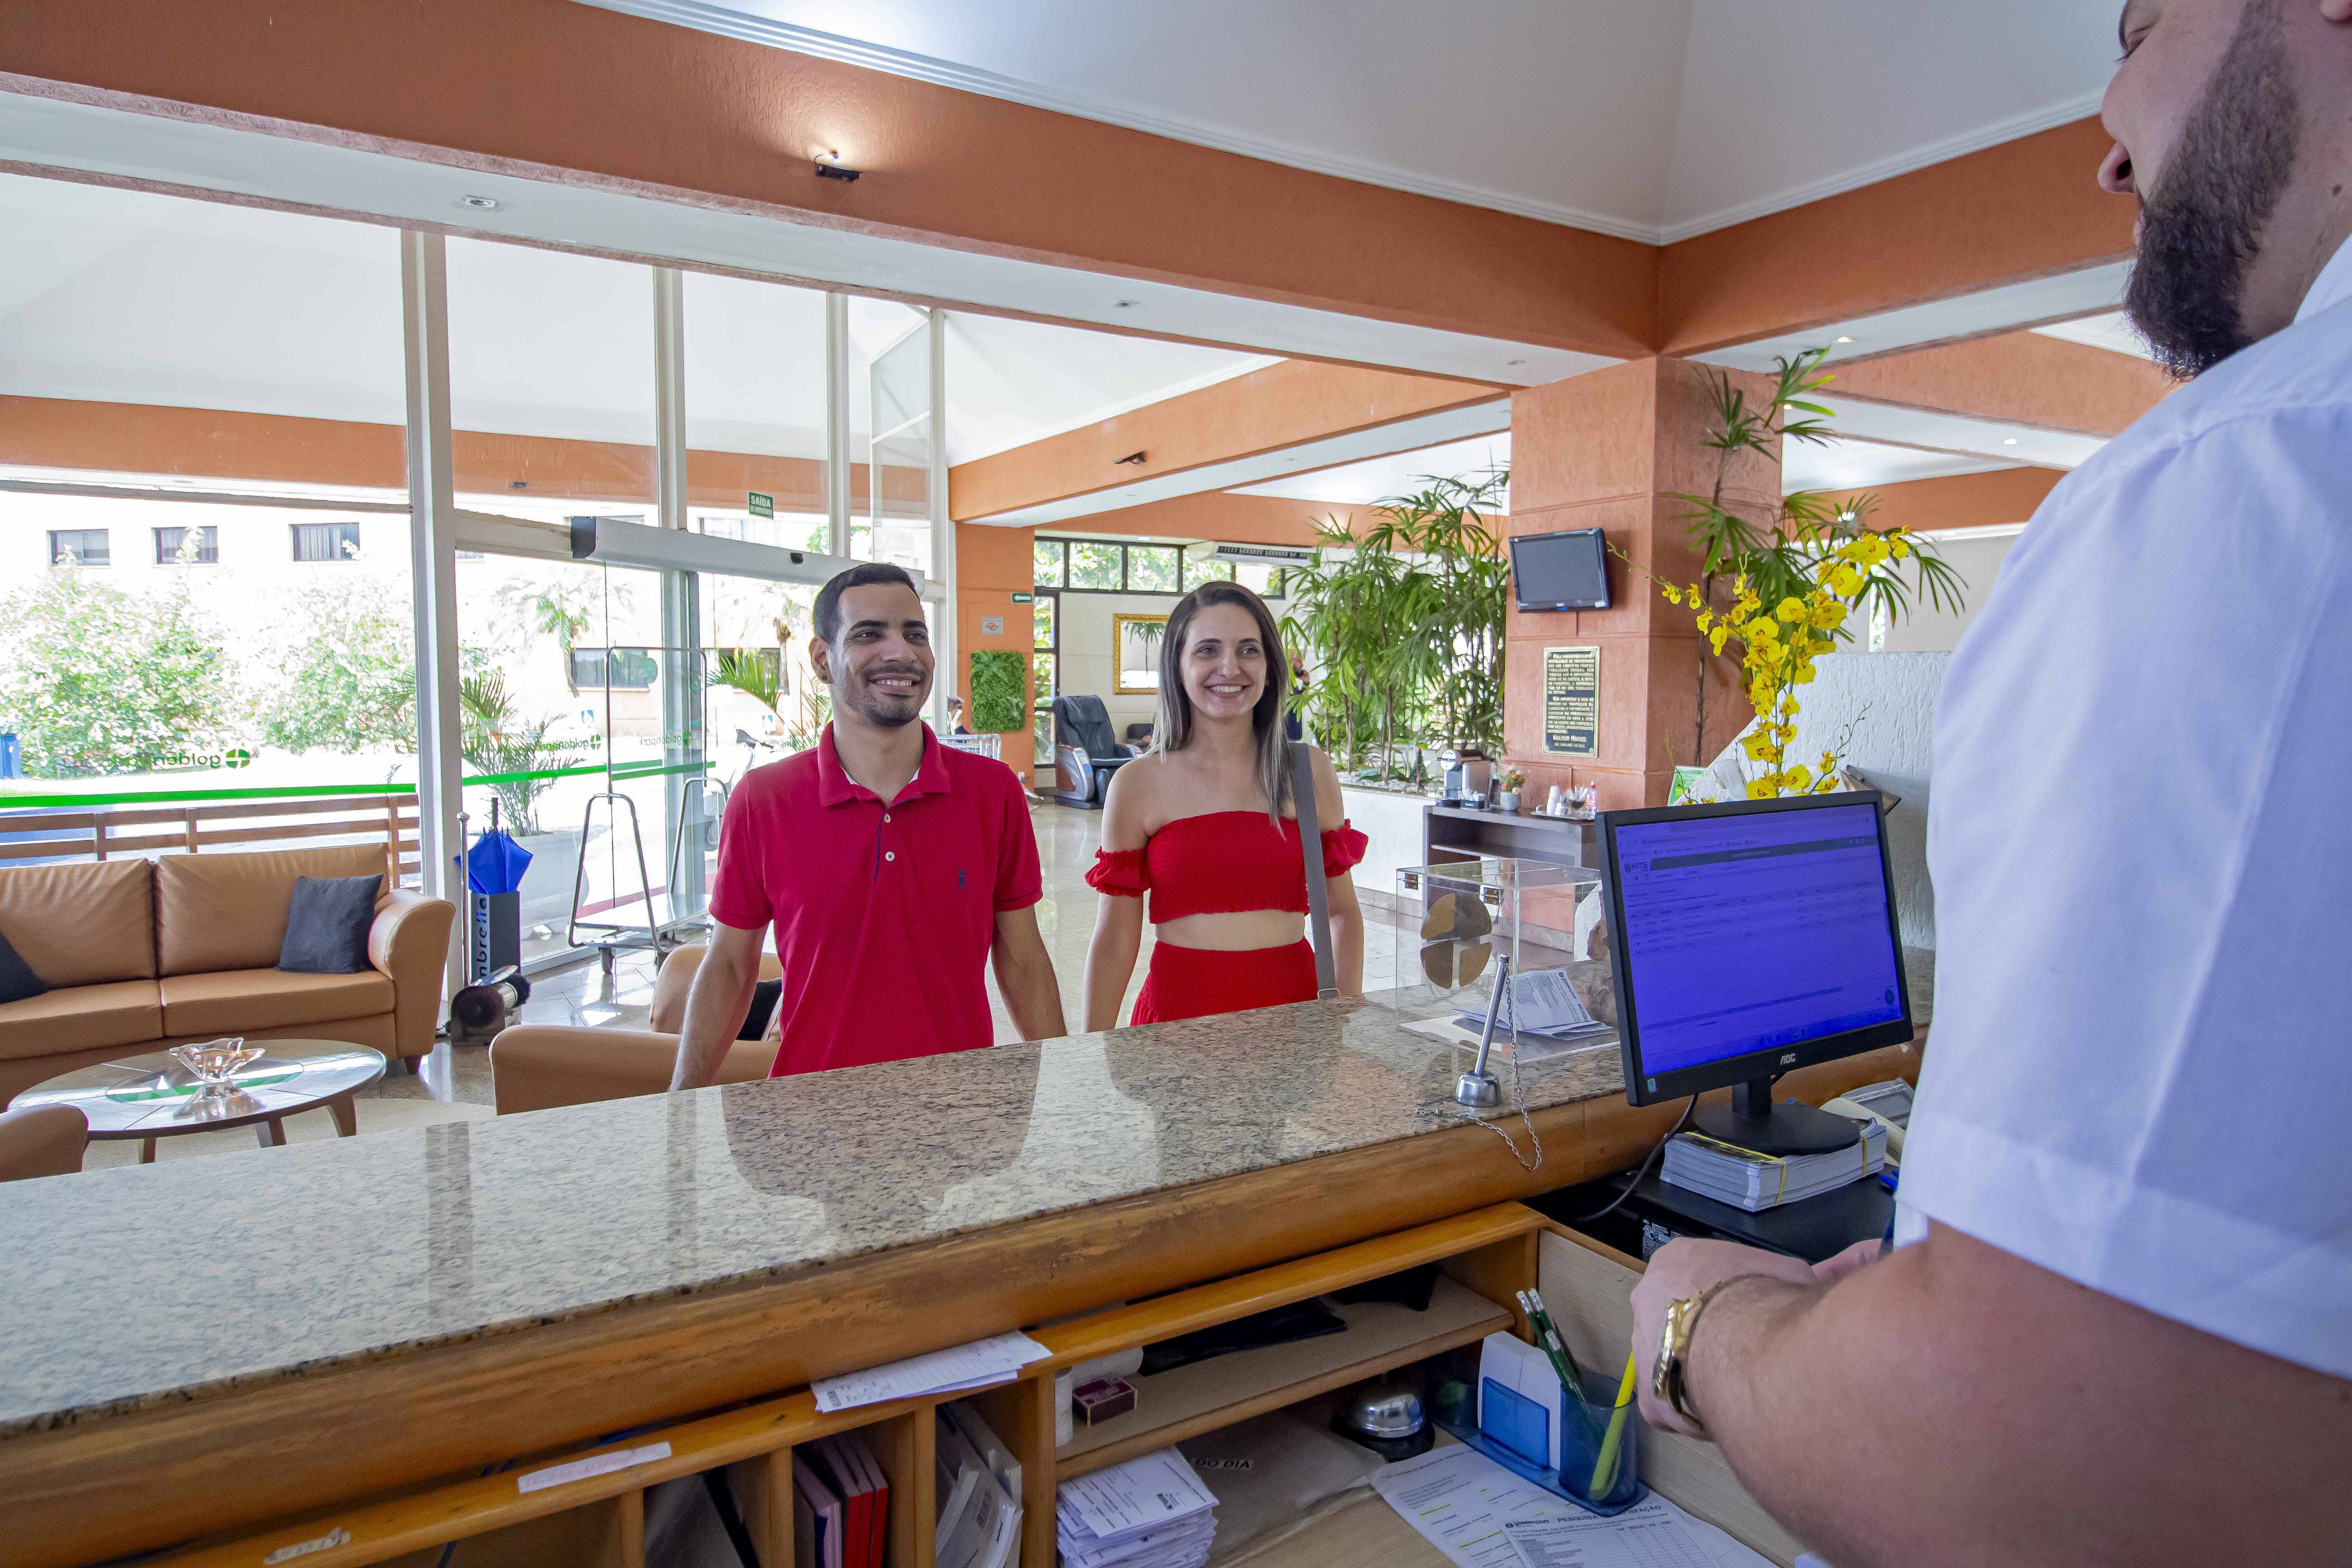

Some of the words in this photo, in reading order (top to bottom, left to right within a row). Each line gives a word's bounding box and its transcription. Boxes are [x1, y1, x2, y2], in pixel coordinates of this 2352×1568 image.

[750, 495, 771, 508] SAÍDA
[475, 897, 488, 978] mbrella
[1577, 1003, 1589, 1022] PESQU
[1780, 1053, 1795, 1065] AOC
[1196, 1458, 1219, 1467] DO
[1223, 1460, 1250, 1469] DIA
[1623, 1505, 1661, 1515] ISFAÇÃO
